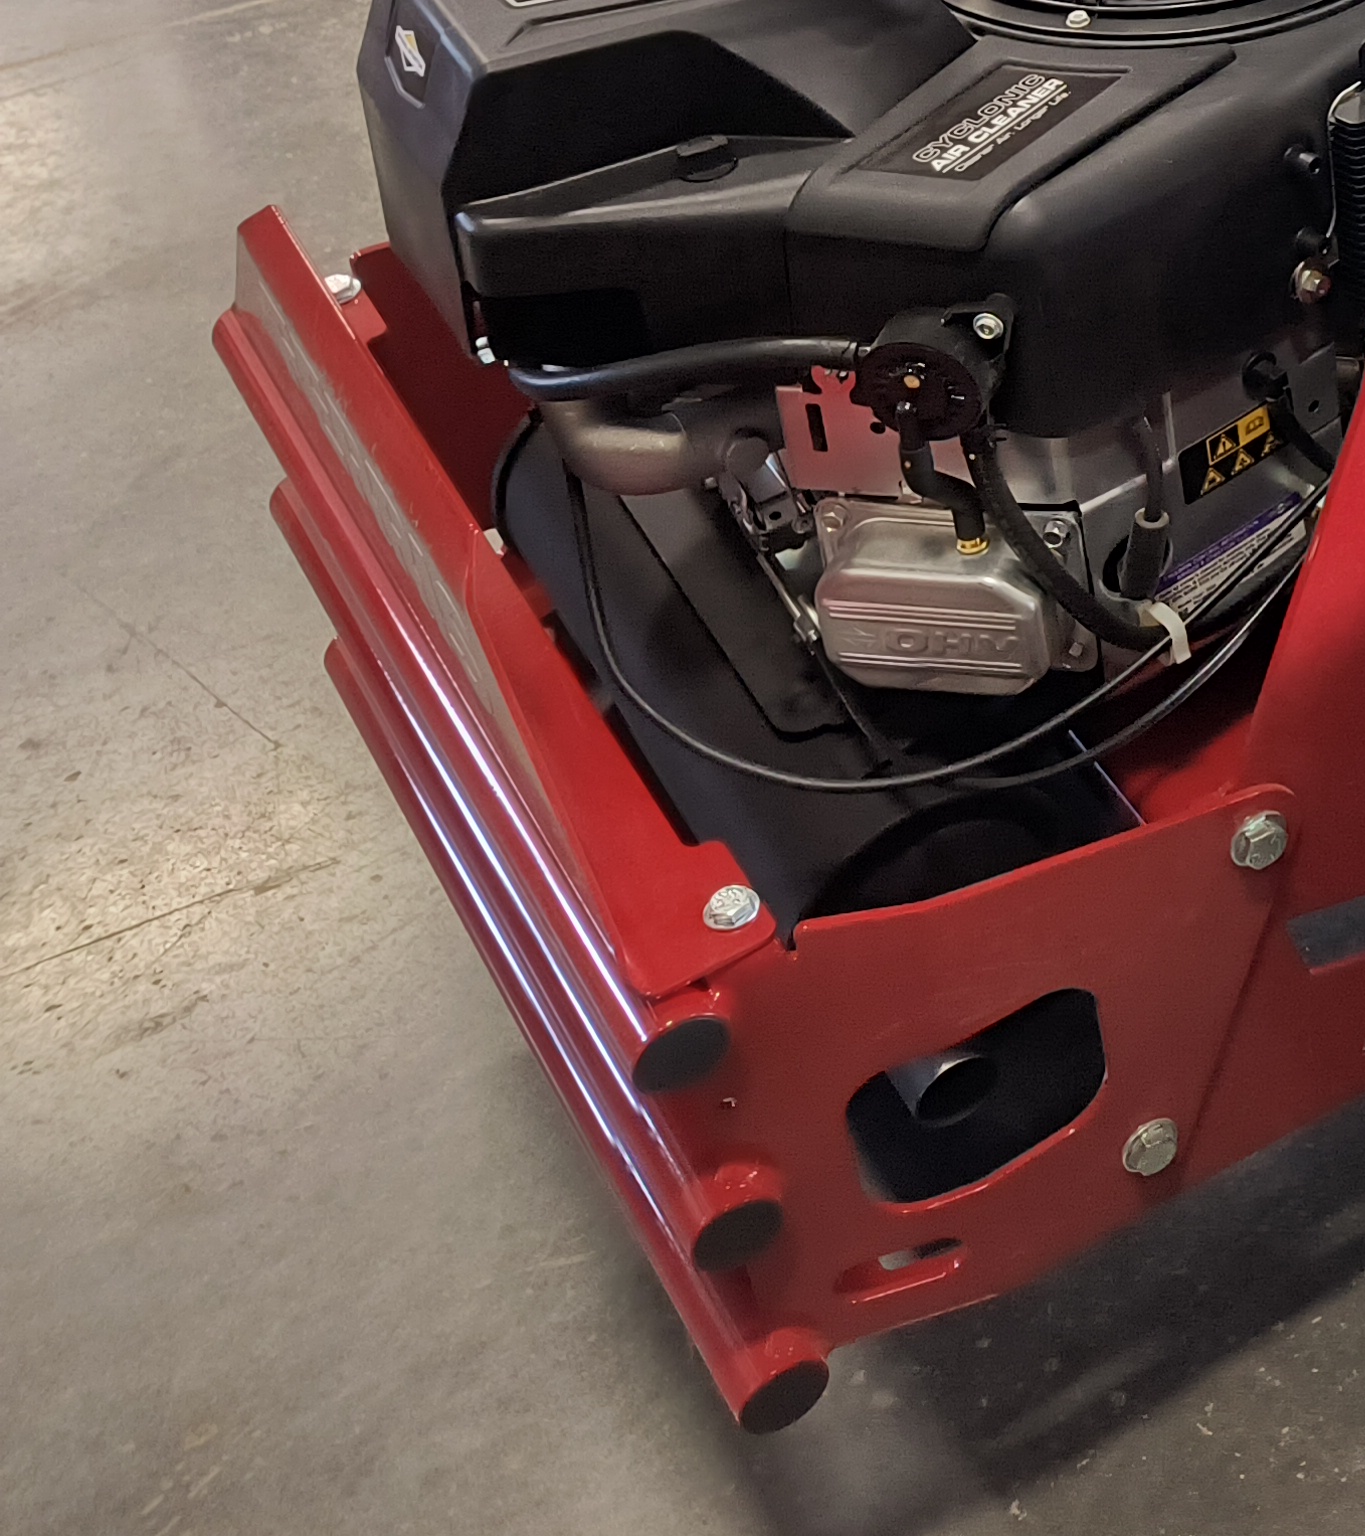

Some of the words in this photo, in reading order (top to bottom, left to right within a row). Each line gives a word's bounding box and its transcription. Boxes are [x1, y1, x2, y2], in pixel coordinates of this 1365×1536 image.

[912, 73, 1046, 163] CYCLONIC
[930, 144, 971, 172] AIR
[968, 77, 1065, 144] CLEANER
[885, 627, 1021, 659] OHV
